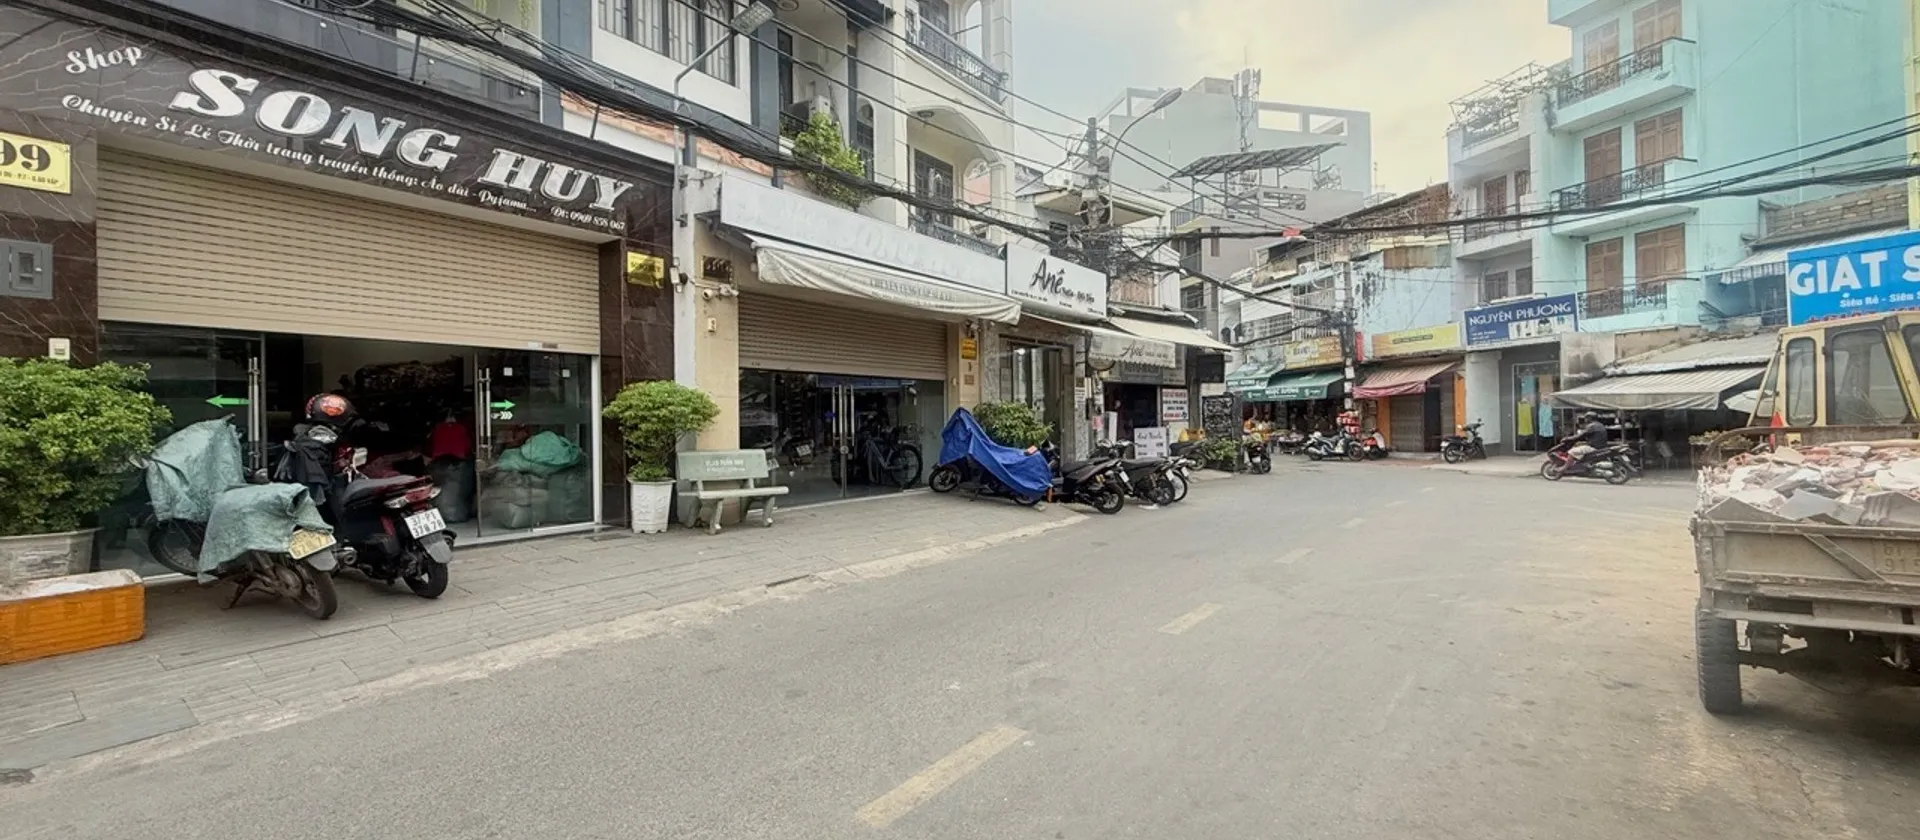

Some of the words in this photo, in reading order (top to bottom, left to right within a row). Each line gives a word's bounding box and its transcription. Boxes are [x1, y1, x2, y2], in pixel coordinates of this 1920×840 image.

[66, 46, 142, 74] Shop
[62, 94, 148, 126] Chuyên
[267, 142, 314, 165] trang
[168, 69, 462, 173] SONG
[477, 148, 634, 211] HUY
